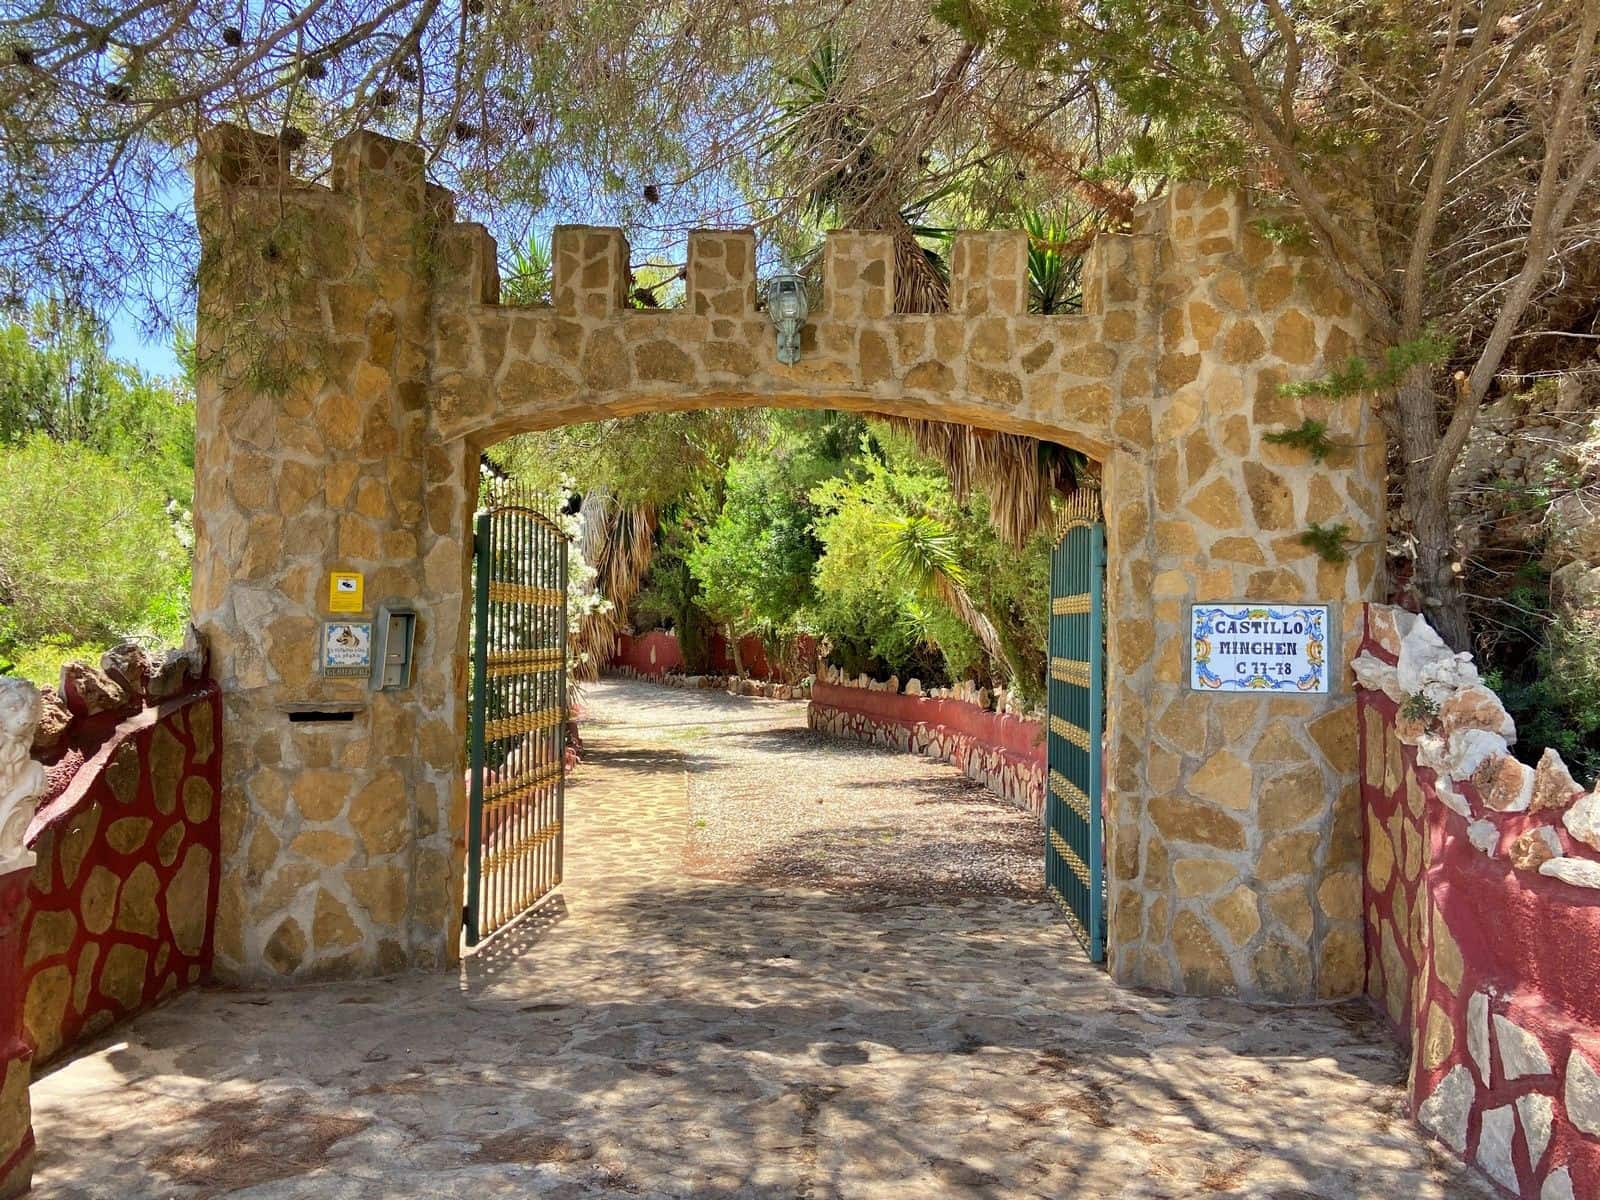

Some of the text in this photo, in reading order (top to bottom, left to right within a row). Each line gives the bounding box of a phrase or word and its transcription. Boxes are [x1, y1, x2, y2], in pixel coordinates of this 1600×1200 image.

[1215, 621, 1303, 634] CASTILLO
[1219, 641, 1297, 655] MINCHEN
[1236, 662, 1292, 675] C 77-78
